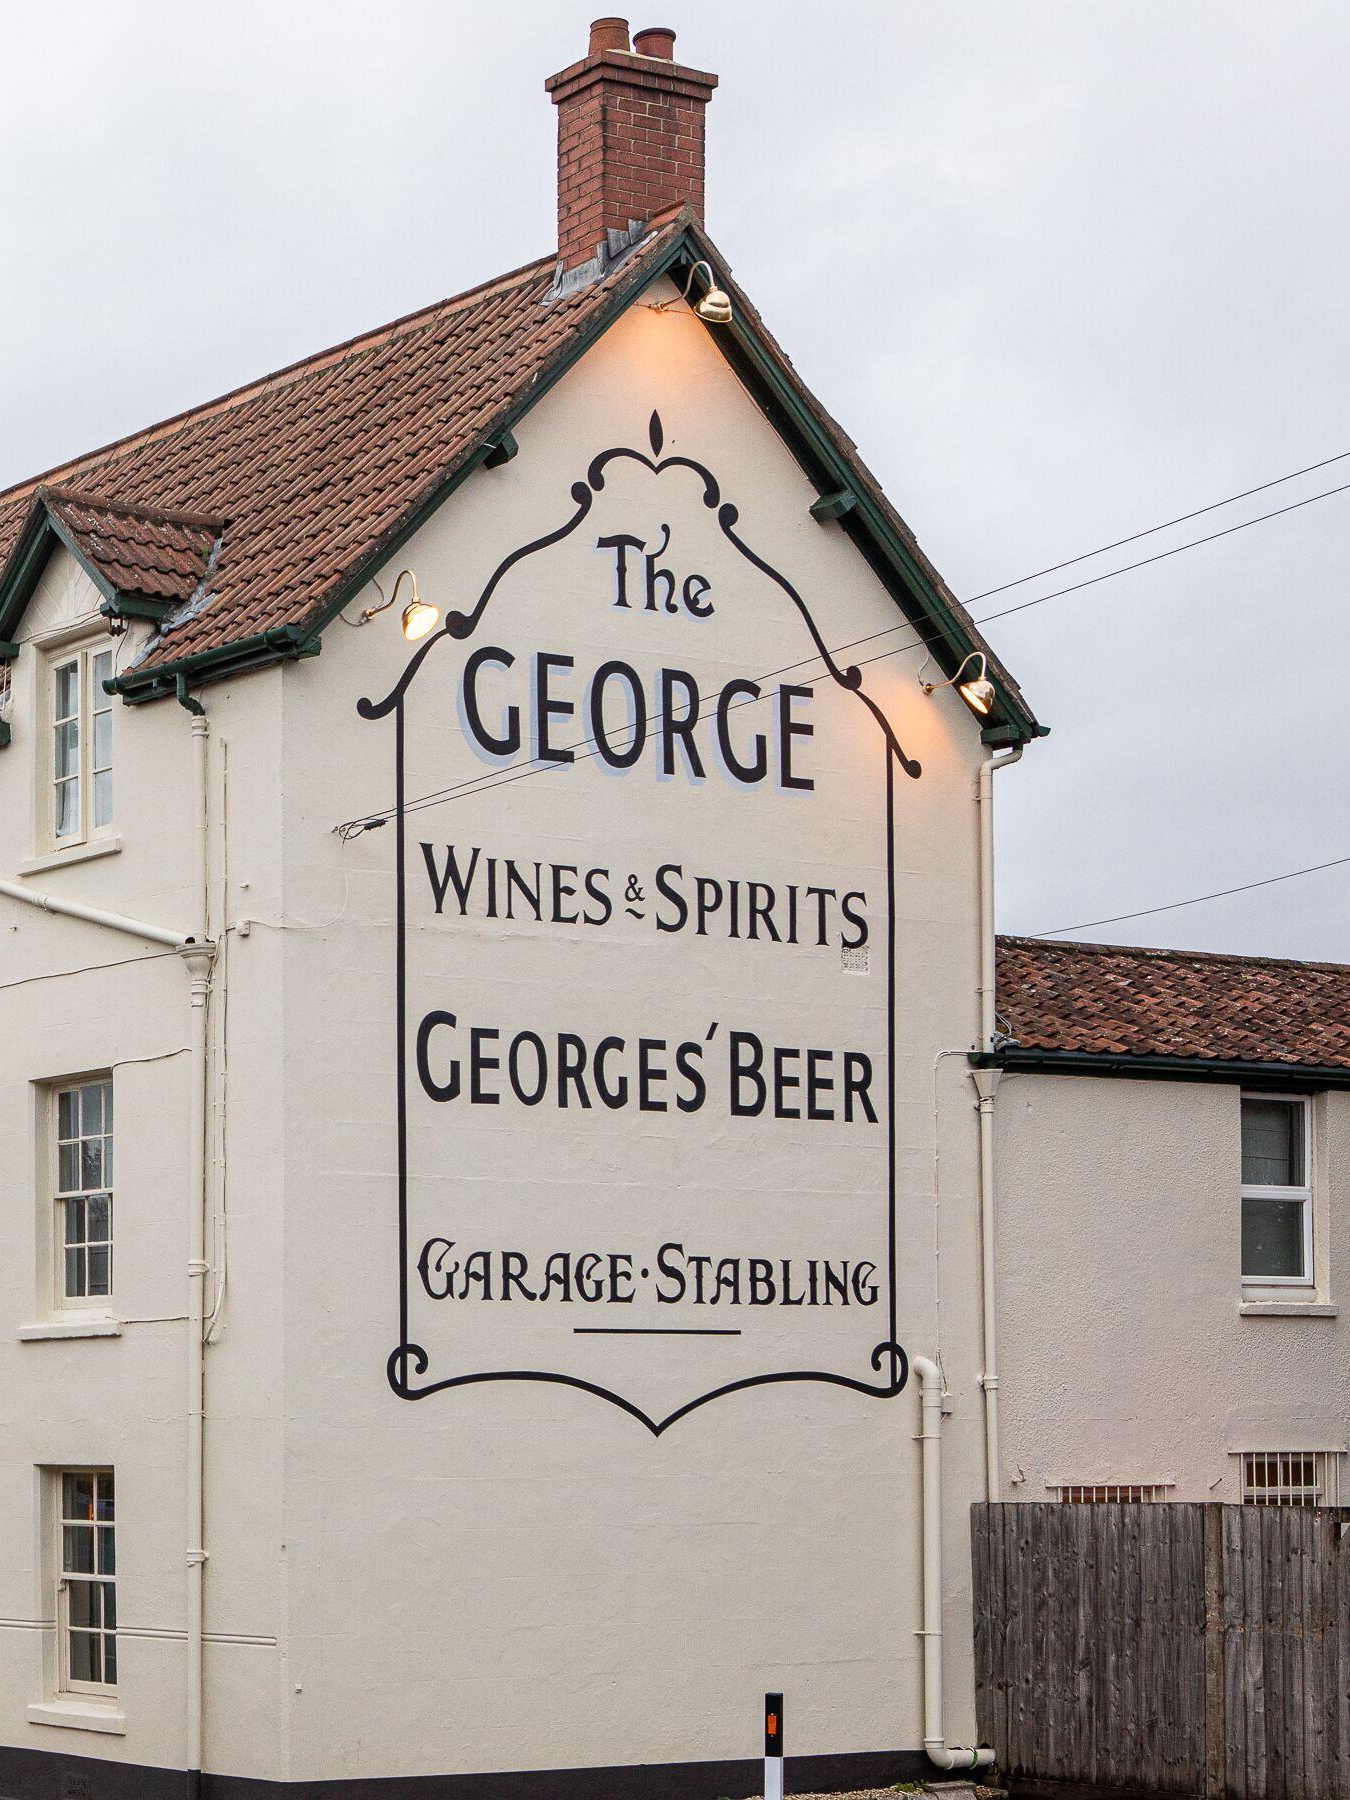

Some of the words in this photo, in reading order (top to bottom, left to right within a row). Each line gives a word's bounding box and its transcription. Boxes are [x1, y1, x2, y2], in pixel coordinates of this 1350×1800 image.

[596, 523, 715, 618] The
[462, 645, 815, 792] GEORGE
[419, 842, 613, 926] WINES
[624, 873, 646, 920] &
[655, 863, 869, 950] SPIRITS
[729, 1030, 879, 1124] BEER
